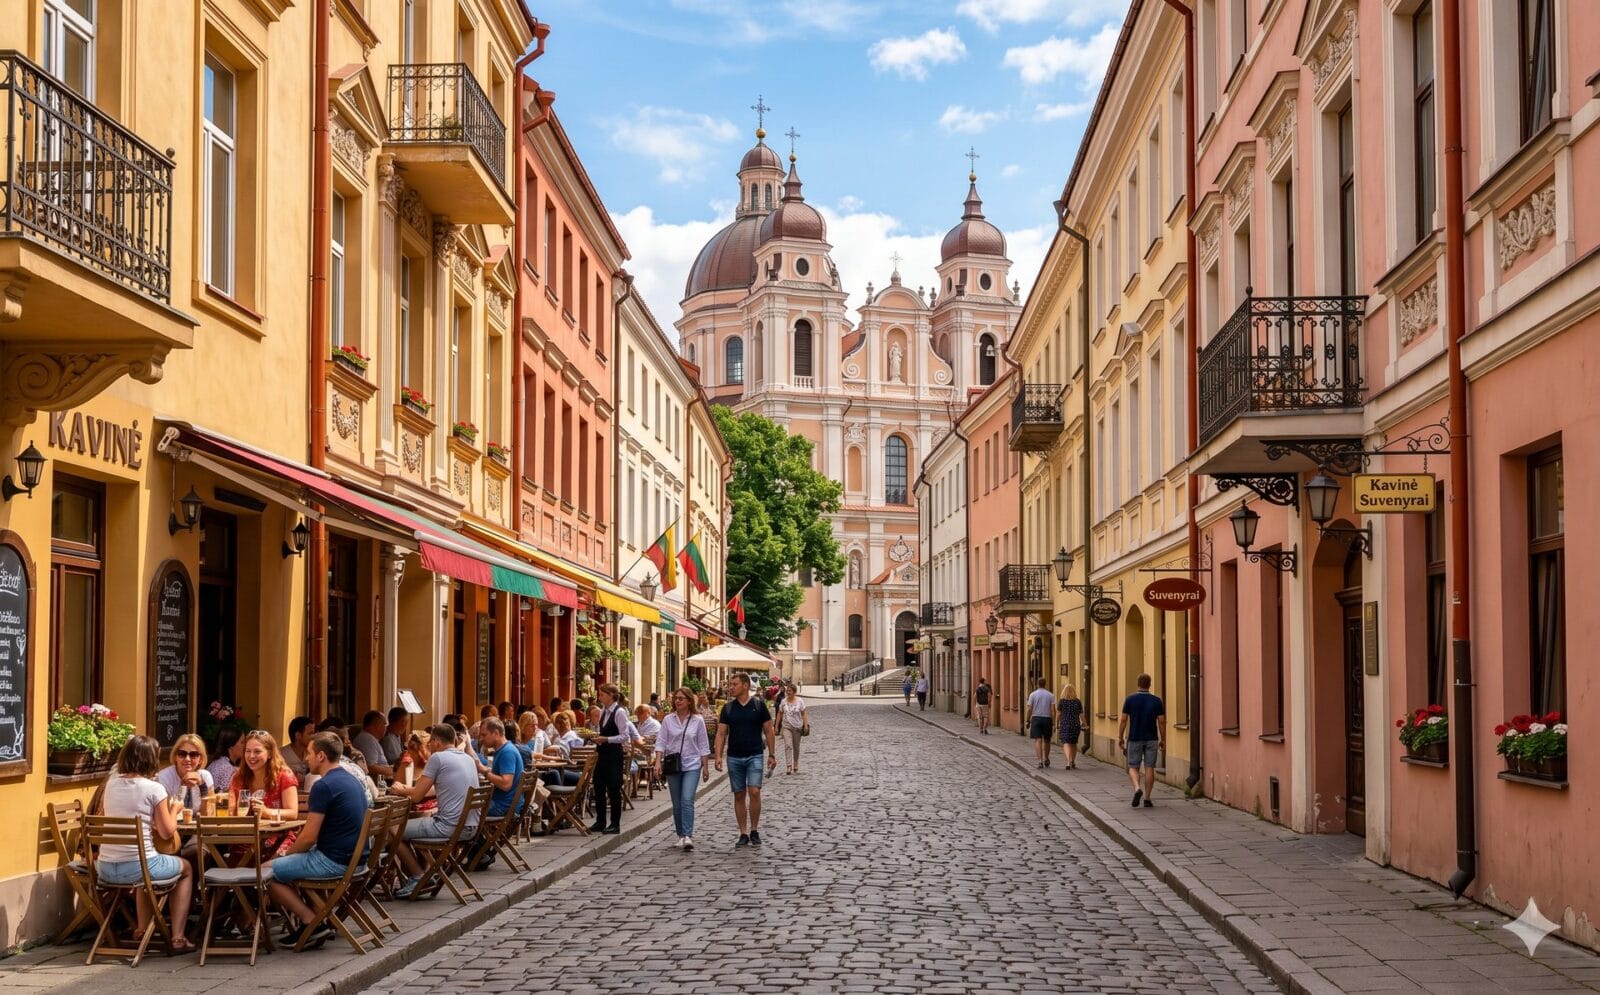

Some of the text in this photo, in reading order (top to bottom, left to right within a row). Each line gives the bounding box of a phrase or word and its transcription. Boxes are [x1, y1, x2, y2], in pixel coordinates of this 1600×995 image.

[49, 410, 142, 469] KAVINĖ
[1370, 478, 1418, 491] Kavinė
[1360, 493, 1429, 509] Suvenyrai
[1149, 590, 1200, 602] Suvenyrai
